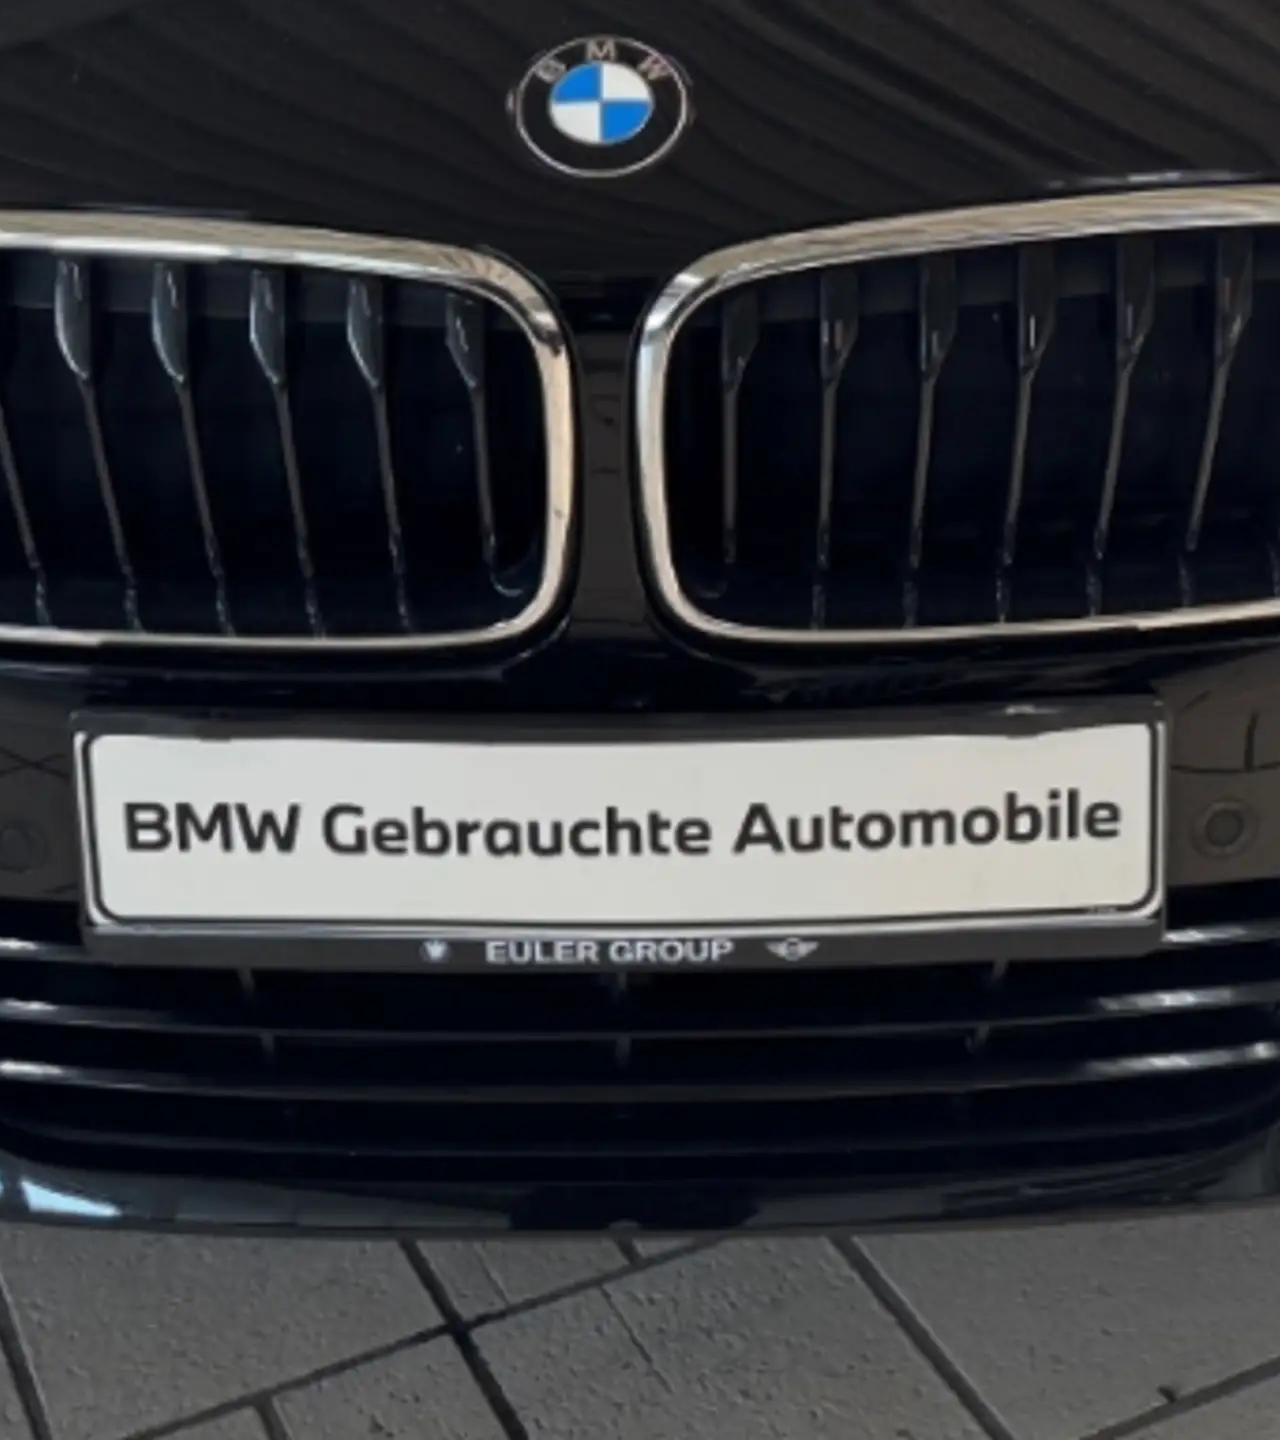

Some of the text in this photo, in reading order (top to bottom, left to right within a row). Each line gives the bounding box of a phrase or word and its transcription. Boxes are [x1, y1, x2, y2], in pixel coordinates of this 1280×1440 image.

[124, 789, 1122, 857] BMW Gebrauchte Automobile
[485, 938, 734, 965] EULER GROUP
